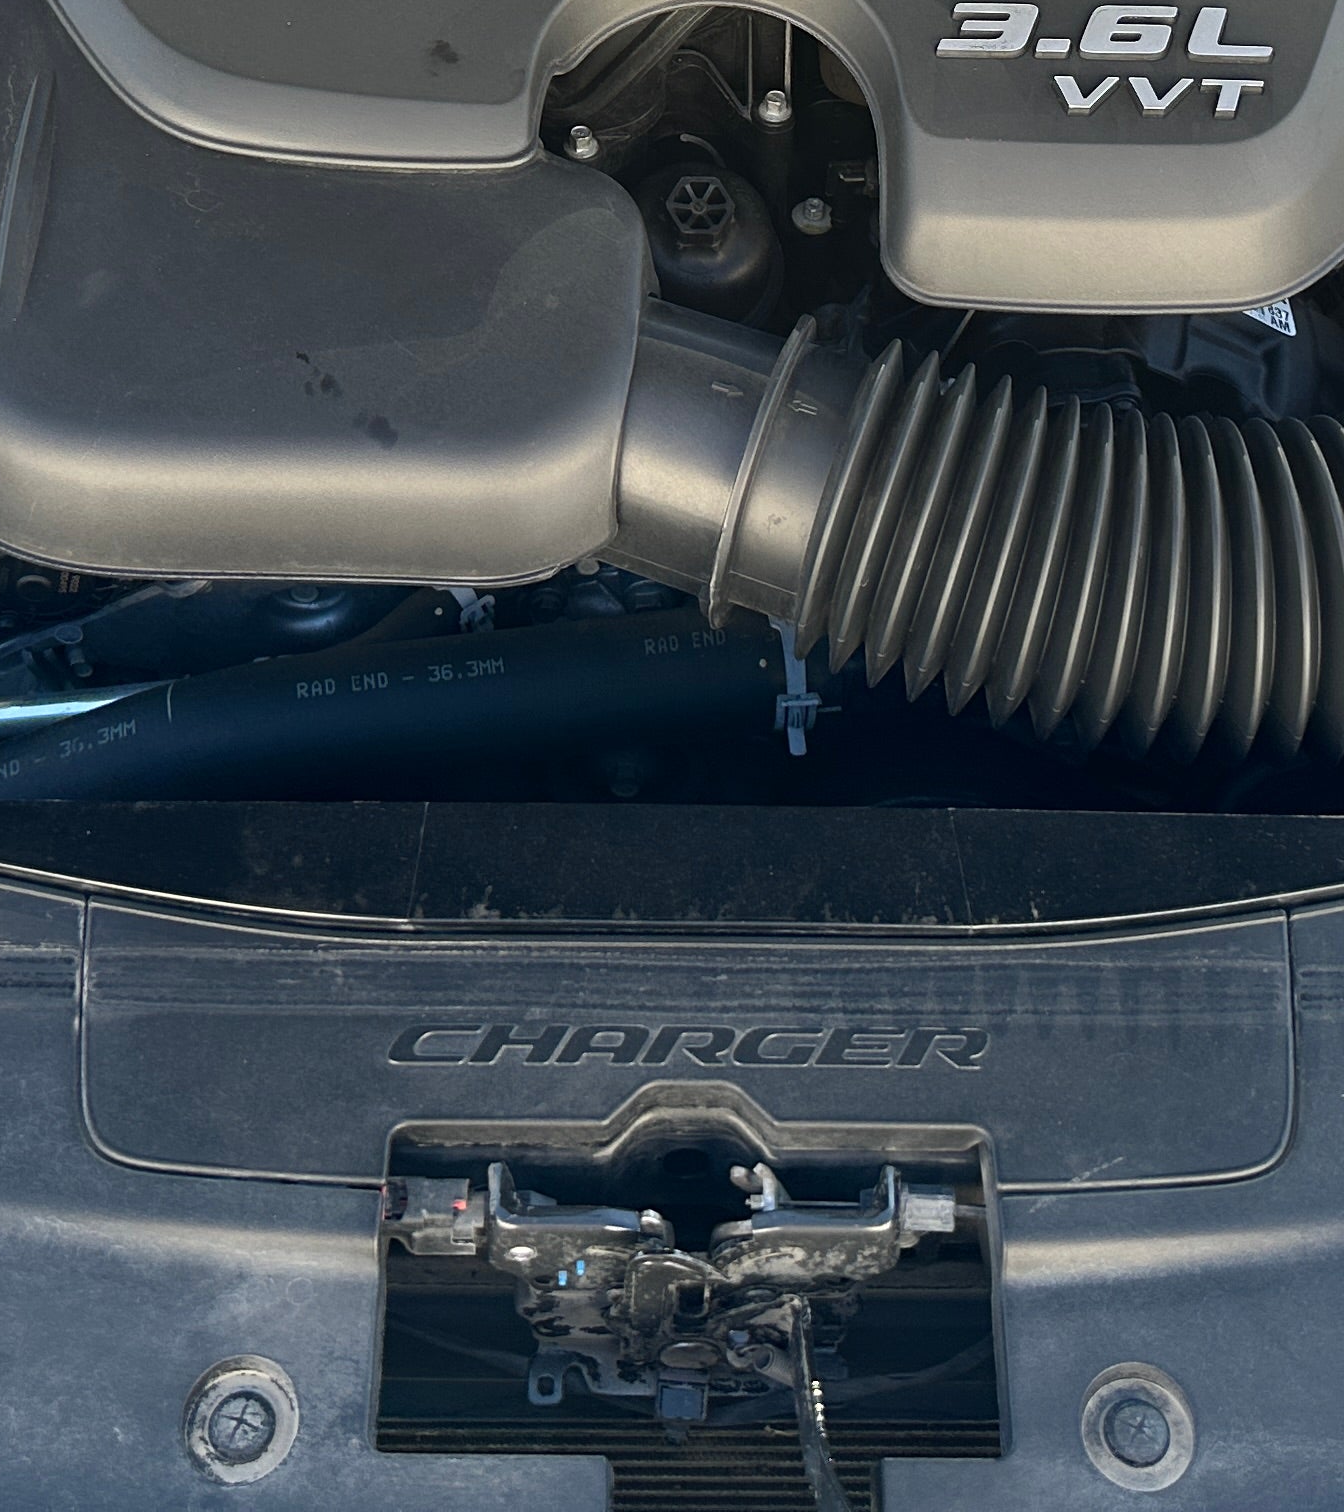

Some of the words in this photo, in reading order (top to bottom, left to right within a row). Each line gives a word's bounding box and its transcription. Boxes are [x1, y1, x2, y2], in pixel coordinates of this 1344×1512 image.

[936, 1, 1275, 61] 3.6L
[1052, 75, 1265, 119] VVT
[644, 635, 680, 656] RAD
[691, 629, 727, 649] END
[296, 678, 336, 700] RAD
[351, 671, 389, 692] END
[427, 656, 506, 683] 36.3MM
[58, 719, 137, 760] 36.3MM
[387, 1023, 990, 1071] CHARGER
